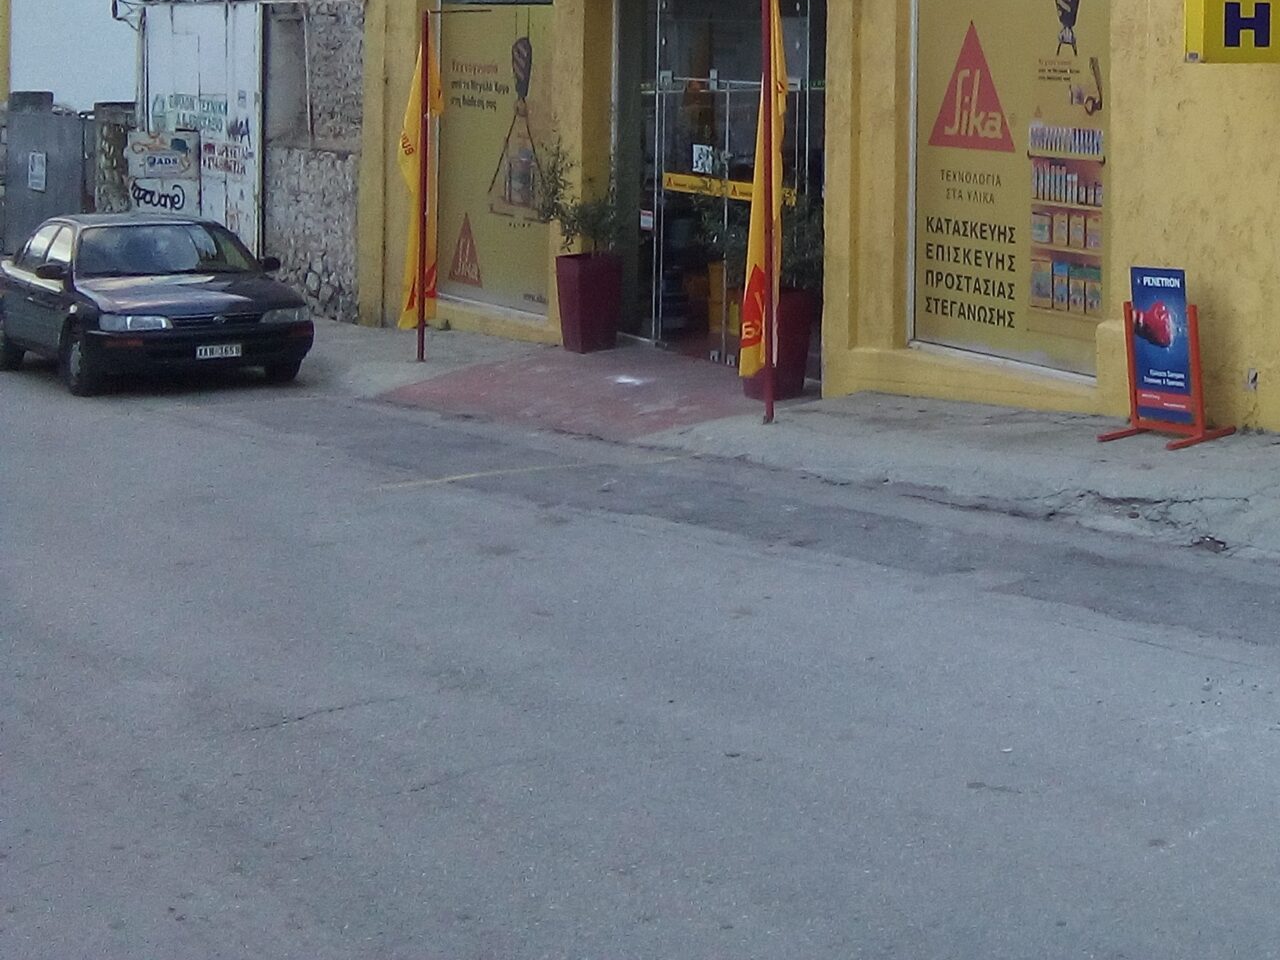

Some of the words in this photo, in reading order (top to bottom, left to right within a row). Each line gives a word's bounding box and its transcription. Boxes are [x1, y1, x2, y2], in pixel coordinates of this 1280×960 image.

[943, 68, 1003, 140] Sika
[940, 169, 1002, 187] ΤΕΧΝΟΛΟΓΙΑ
[926, 216, 1016, 244] ΚΑΤΑΣΚΕΥΗΣ
[926, 243, 1016, 272] ΕΠΙΣΚΕΥΗΣ
[925, 269, 1016, 300] ΠΡΟΣΤΑΣΙΑΣ
[1143, 276, 1181, 289] PENETRON
[925, 296, 1016, 328] ΣΤΕΓΑΝΩΣΗΣ
